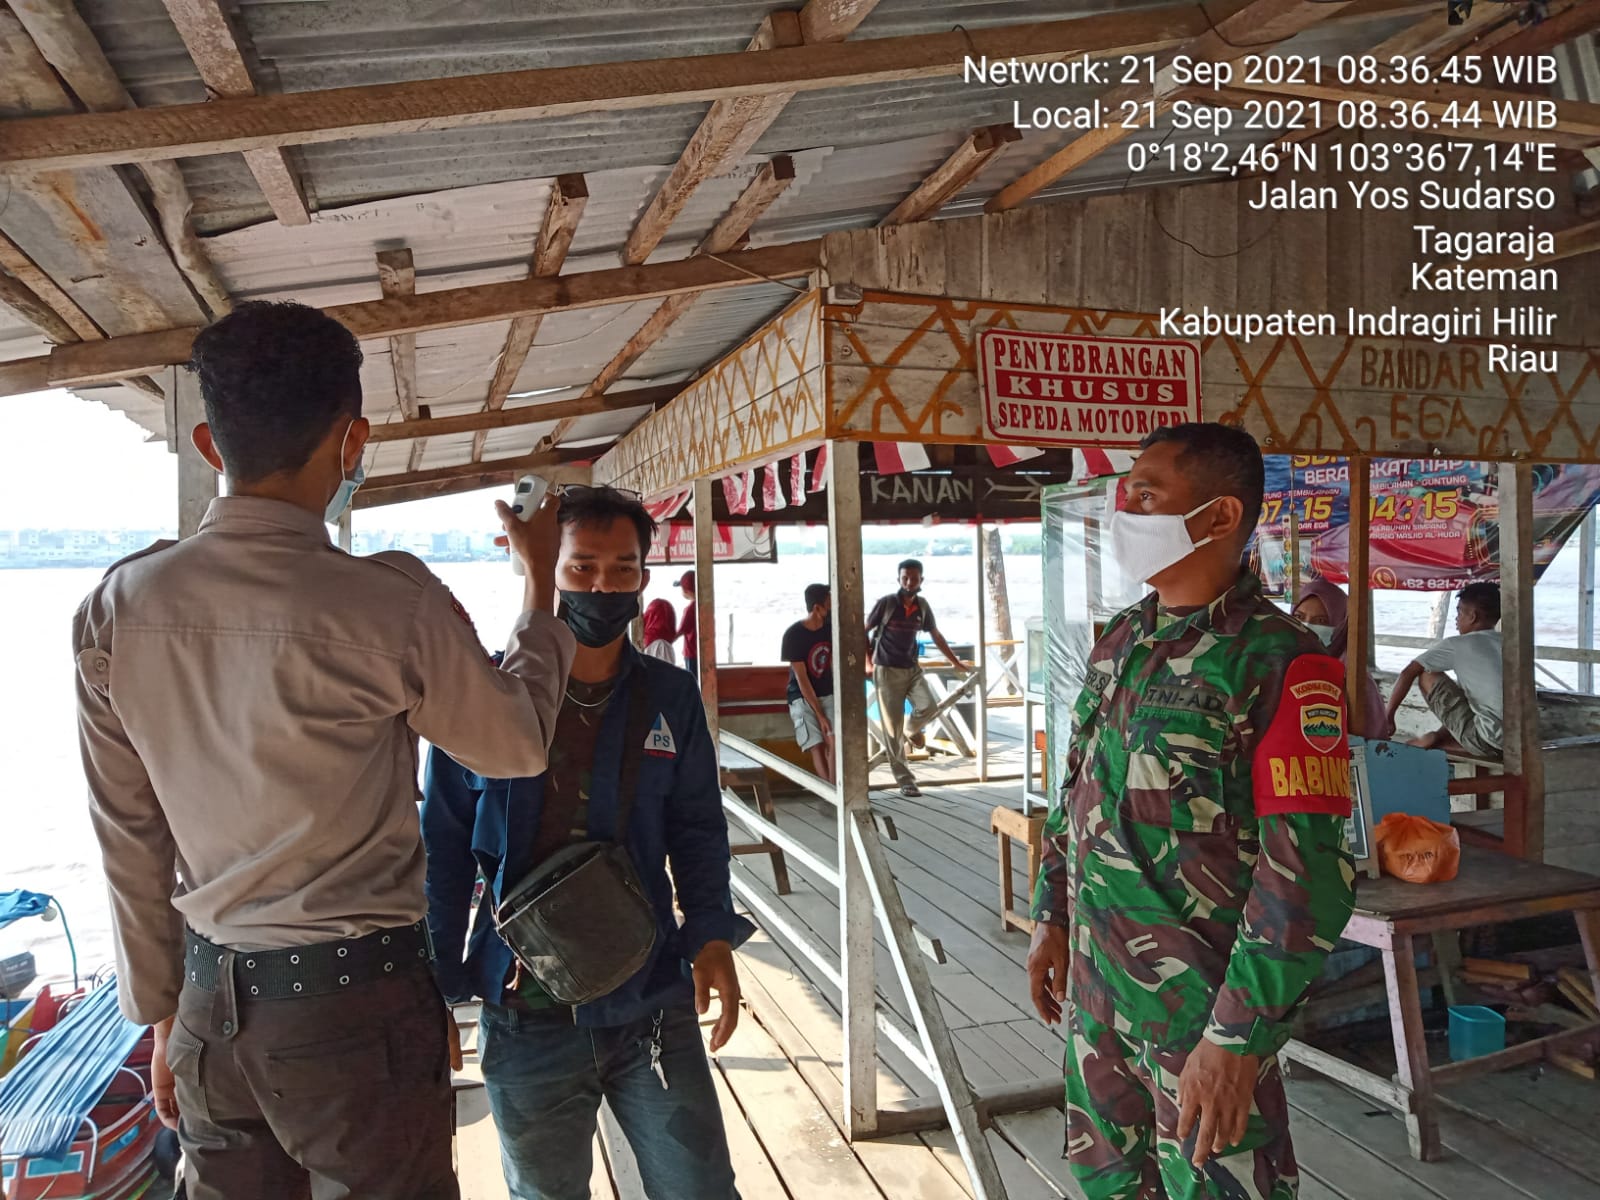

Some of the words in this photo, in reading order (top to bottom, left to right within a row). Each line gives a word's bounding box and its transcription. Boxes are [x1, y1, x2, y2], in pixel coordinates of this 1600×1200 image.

[993, 337, 1186, 378] PENYEBRANGAN
[1361, 345, 1484, 391] BANDAR
[1008, 375, 1175, 403] KHUSUS
[999, 401, 1073, 432] SEPEDA
[1390, 392, 1477, 441] EGA
[870, 475, 974, 504] KANAN
[653, 733, 671, 748] PS
